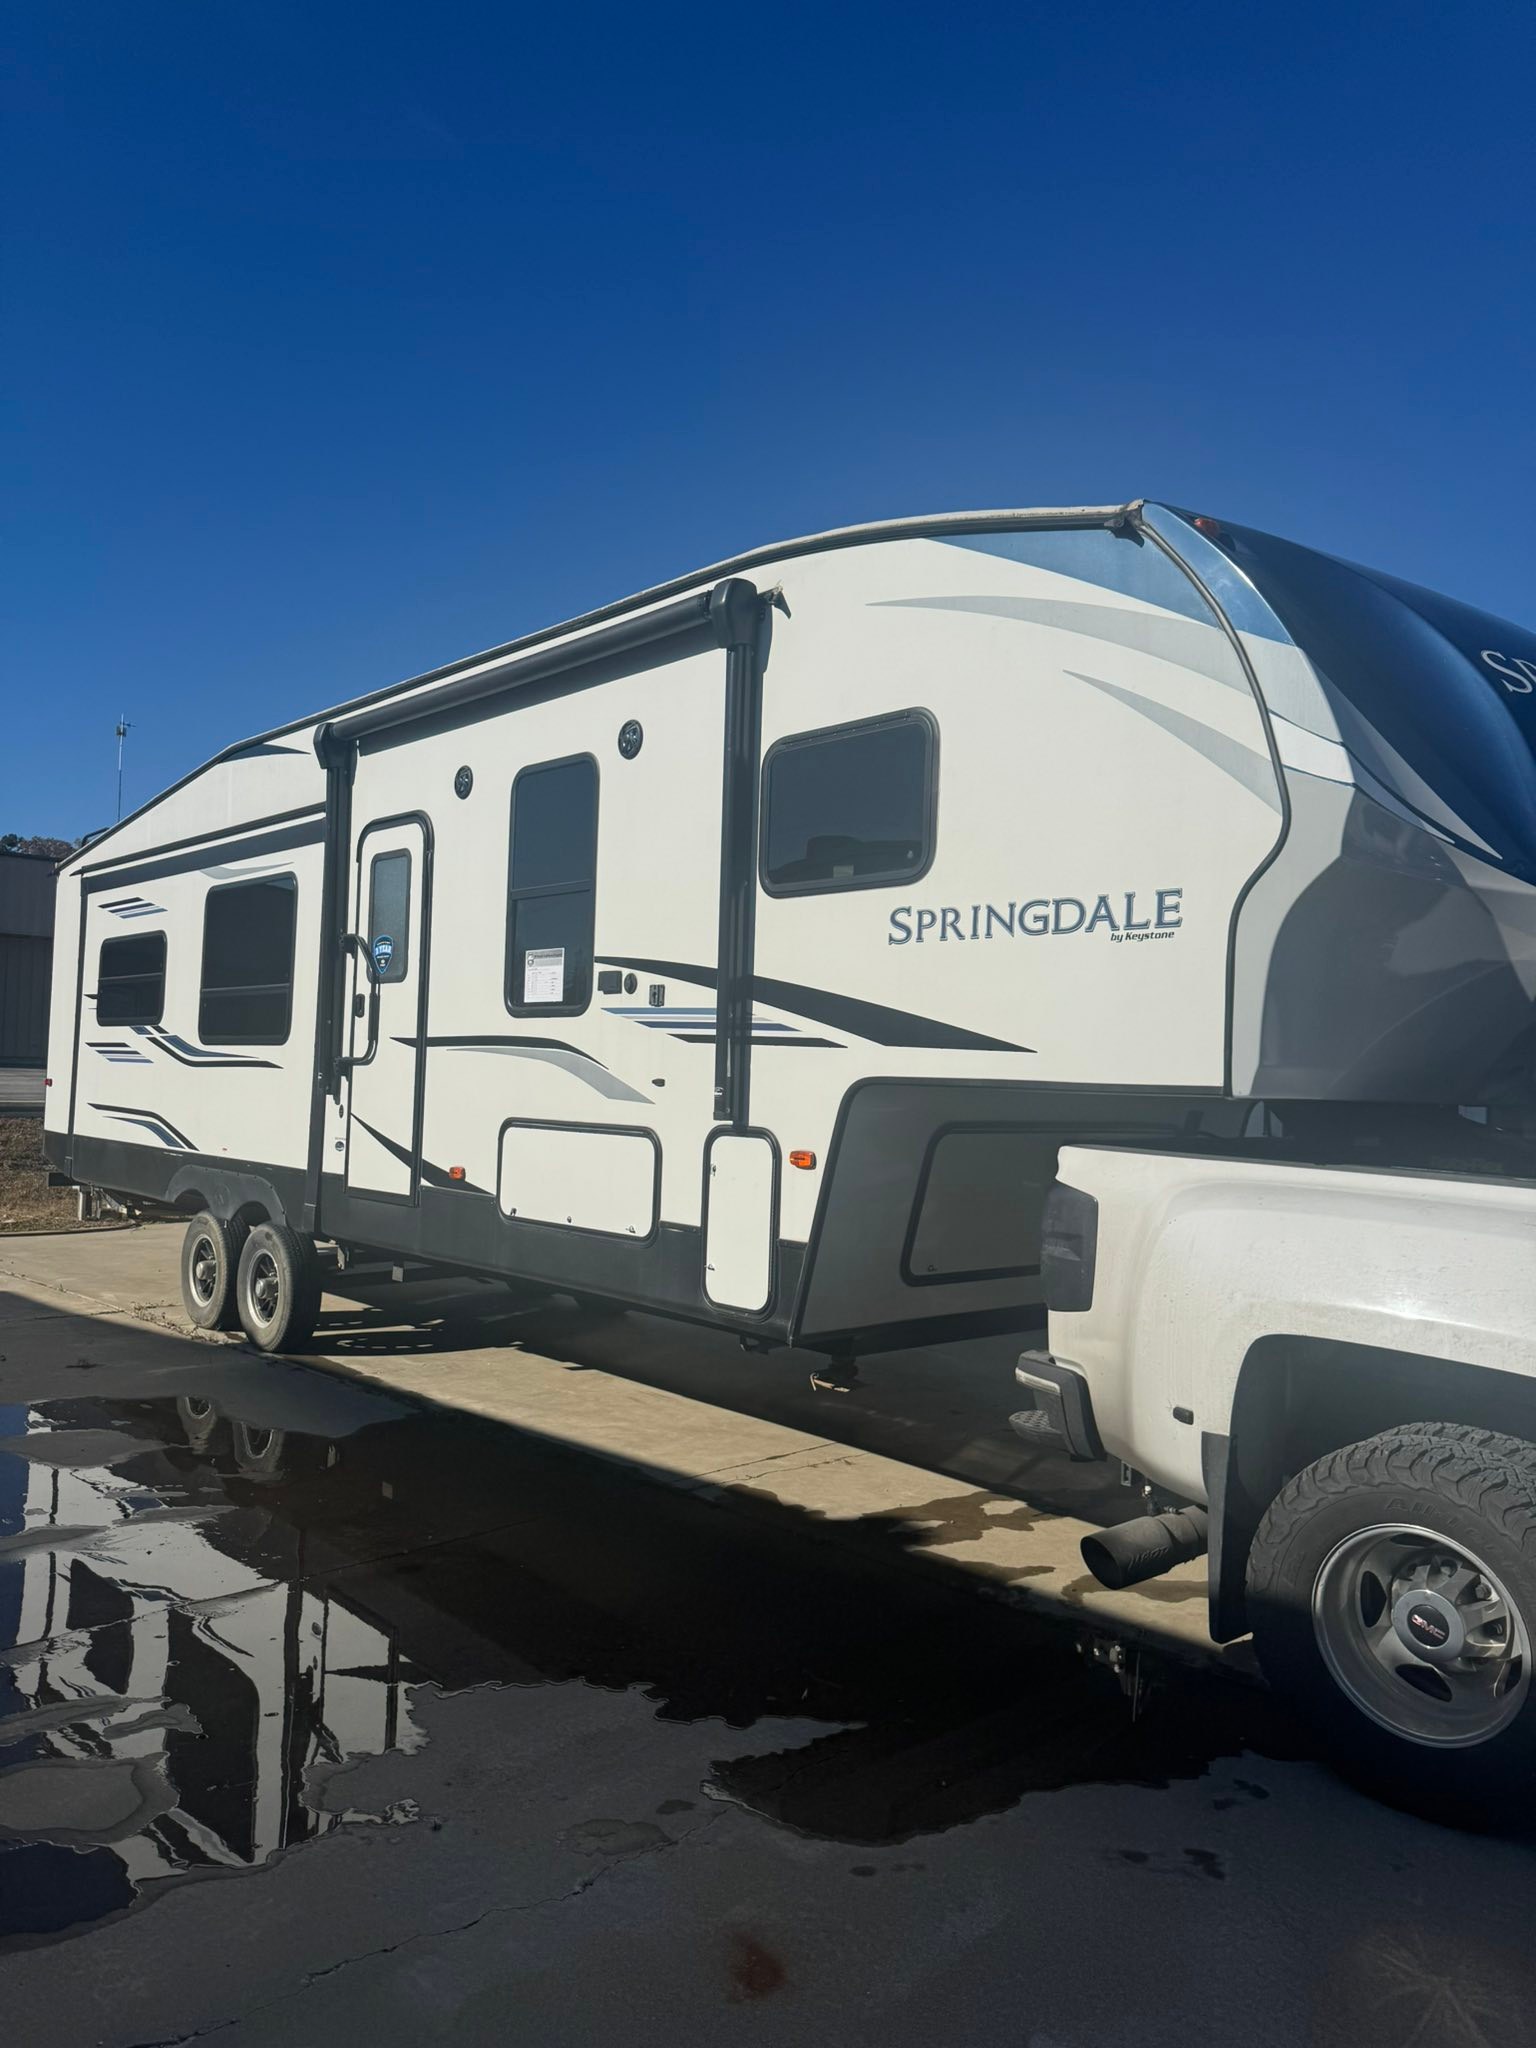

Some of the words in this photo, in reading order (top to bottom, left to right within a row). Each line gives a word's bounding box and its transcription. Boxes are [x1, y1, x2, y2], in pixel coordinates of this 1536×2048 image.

[888, 887, 1183, 945] SPRINGDALE
[1110, 932, 1123, 943] by
[1125, 931, 1175, 942] Keystone
[1411, 1614, 1446, 1640] GMC
